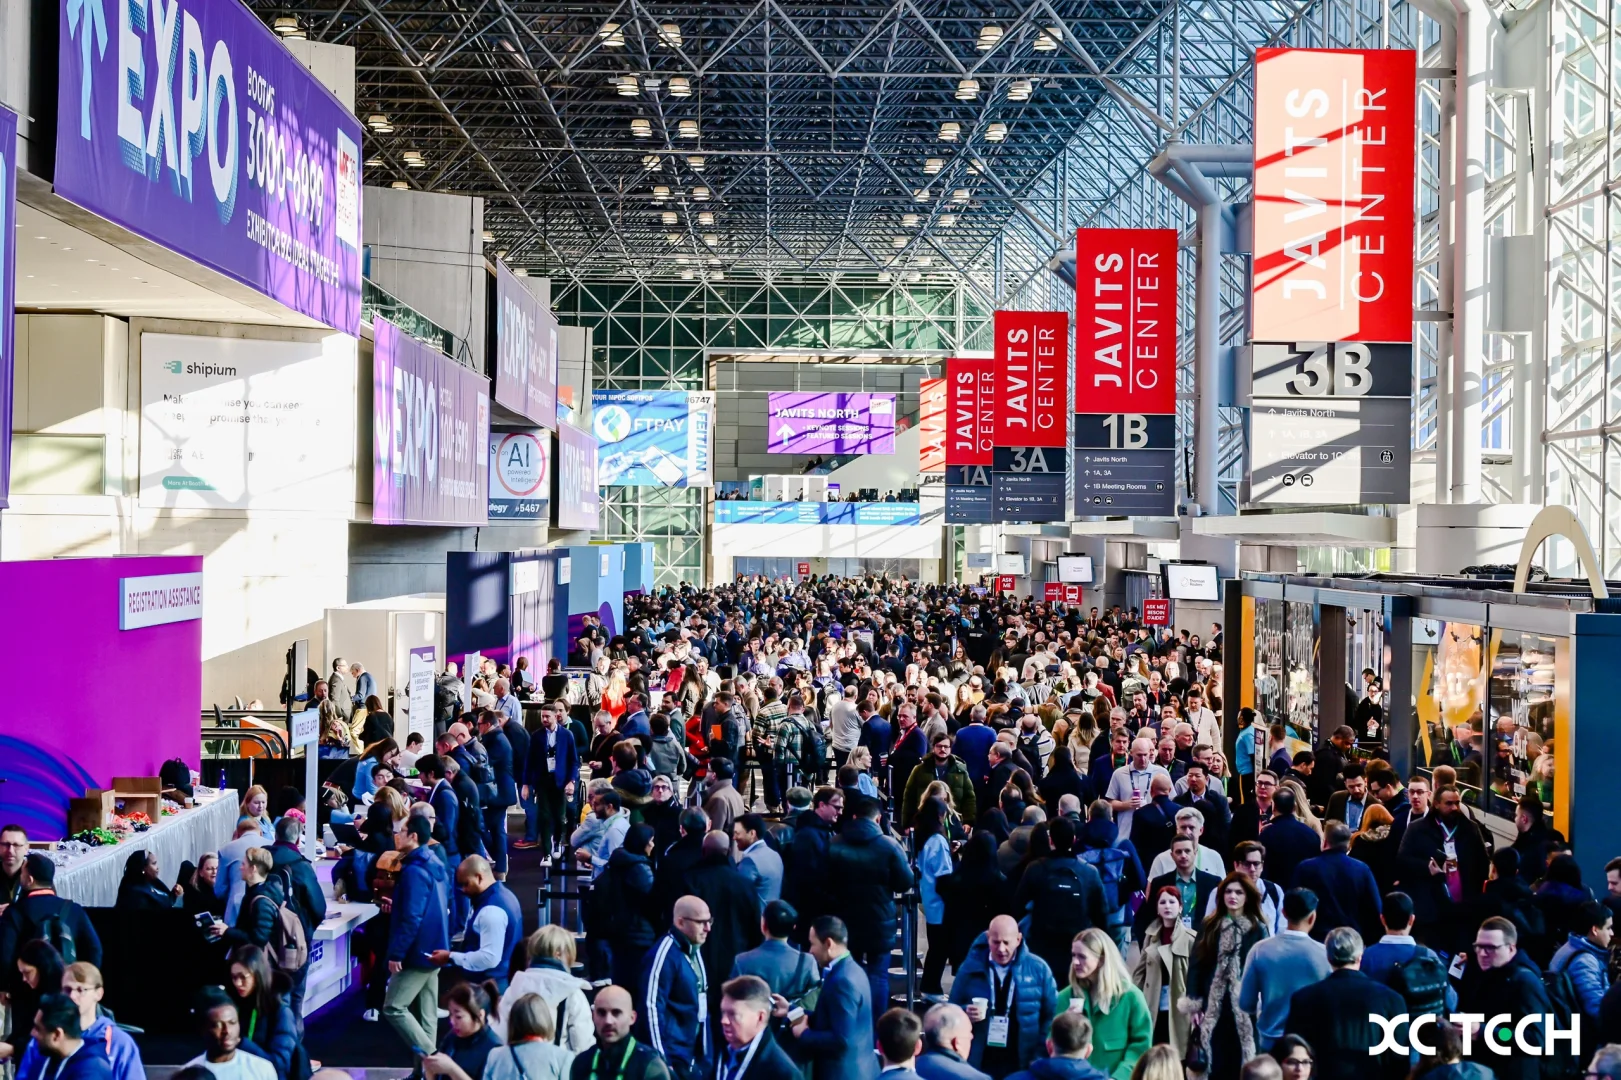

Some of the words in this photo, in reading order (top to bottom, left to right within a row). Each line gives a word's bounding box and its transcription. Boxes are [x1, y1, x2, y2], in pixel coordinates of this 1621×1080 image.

[118, 0, 238, 220] EXPO
[247, 65, 275, 117] BOOTHS
[247, 106, 324, 227] 3000-6999
[1283, 88, 1330, 300] JAVITS
[1350, 87, 1386, 303] CENTER
[247, 210, 280, 257] EXHIBITOR
[310, 251, 330, 283] STAGES
[504, 296, 527, 384] EXPO
[1094, 253, 1124, 387] JAVITS
[1136, 252, 1159, 389] CENTER
[186, 362, 237, 378] shipium
[1007, 328, 1029, 428] JAVITS
[1037, 328, 1055, 429] CENTER
[1293, 342, 1373, 396] 3B
[393, 366, 438, 484] EXPO
[634, 418, 685, 432] FTPAY
[685, 396, 711, 404] #6747
[775, 408, 815, 418] JAVITS
[818, 409, 859, 419] NORTH
[928, 391, 944, 459] JAVITS
[956, 372, 974, 450] JAVITS
[980, 371, 994, 451] CENTER
[1281, 408, 1307, 417] Javits
[1310, 408, 1336, 417] North
[508, 443, 529, 467] AI
[696, 412, 707, 471] FEITIAN
[1010, 447, 1049, 472] 3A
[1102, 414, 1149, 449] 1B
[1281, 451, 1318, 460] Elevator
[1320, 452, 1329, 460] to
[959, 466, 988, 485] 1A
[515, 503, 540, 513] #5467
[128, 589, 167, 614] REGISTRATION
[168, 585, 201, 608] ASSISTANCE
